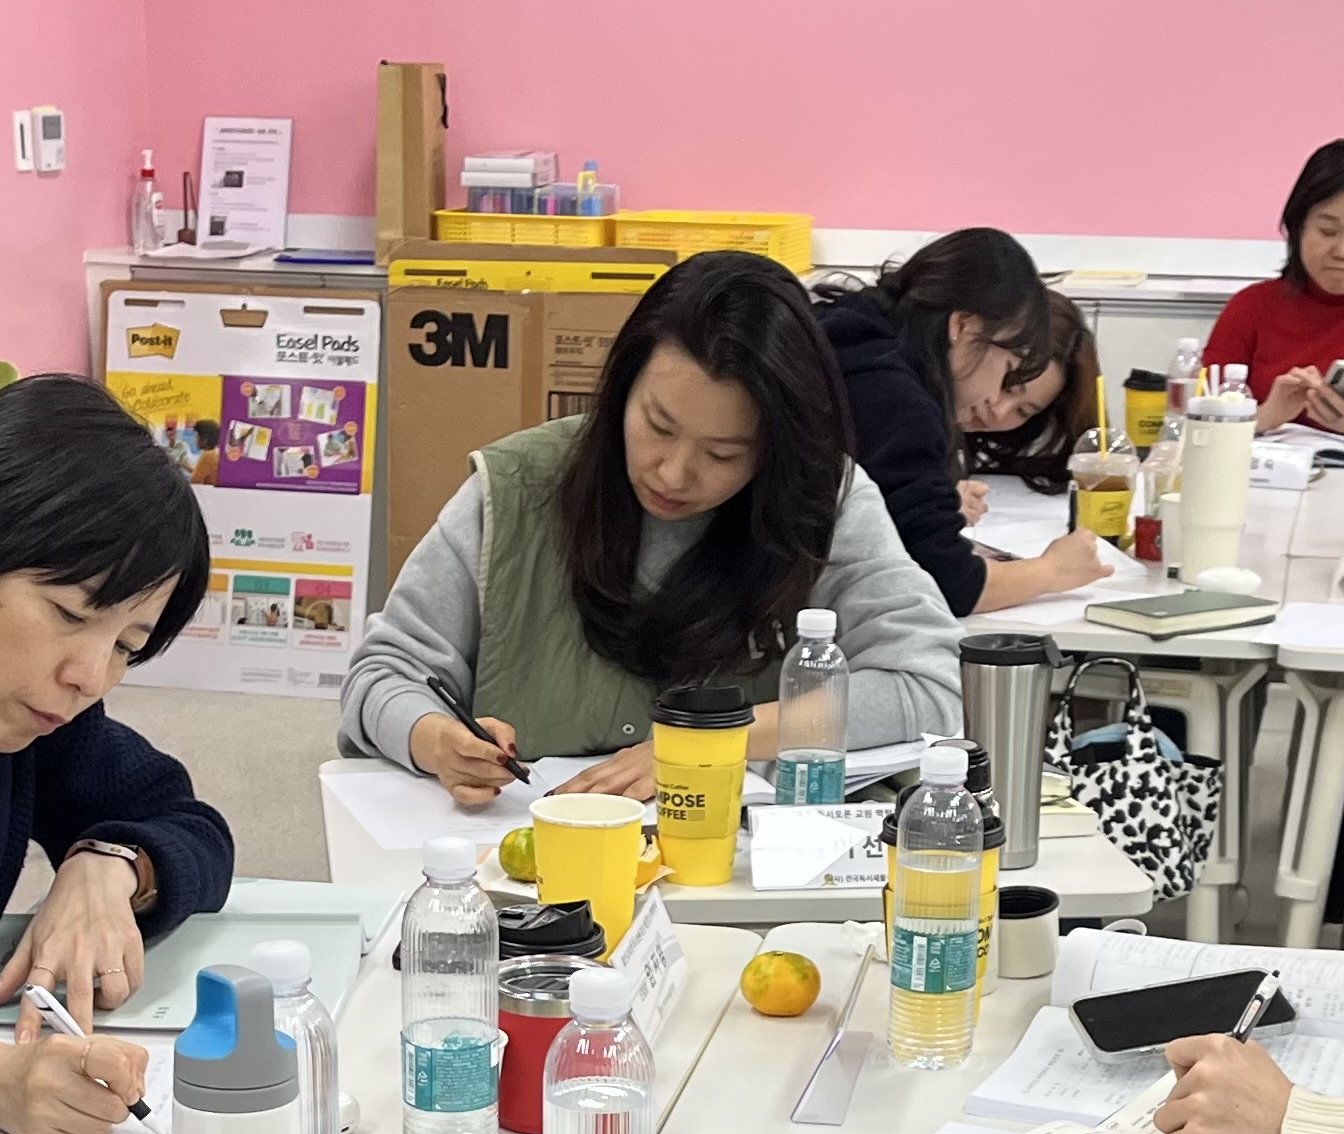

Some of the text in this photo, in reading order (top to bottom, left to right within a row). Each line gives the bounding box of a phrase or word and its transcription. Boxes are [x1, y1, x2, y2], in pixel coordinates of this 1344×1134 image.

[276, 333, 360, 352] Easel Pads
[409, 309, 509, 369] 3M
